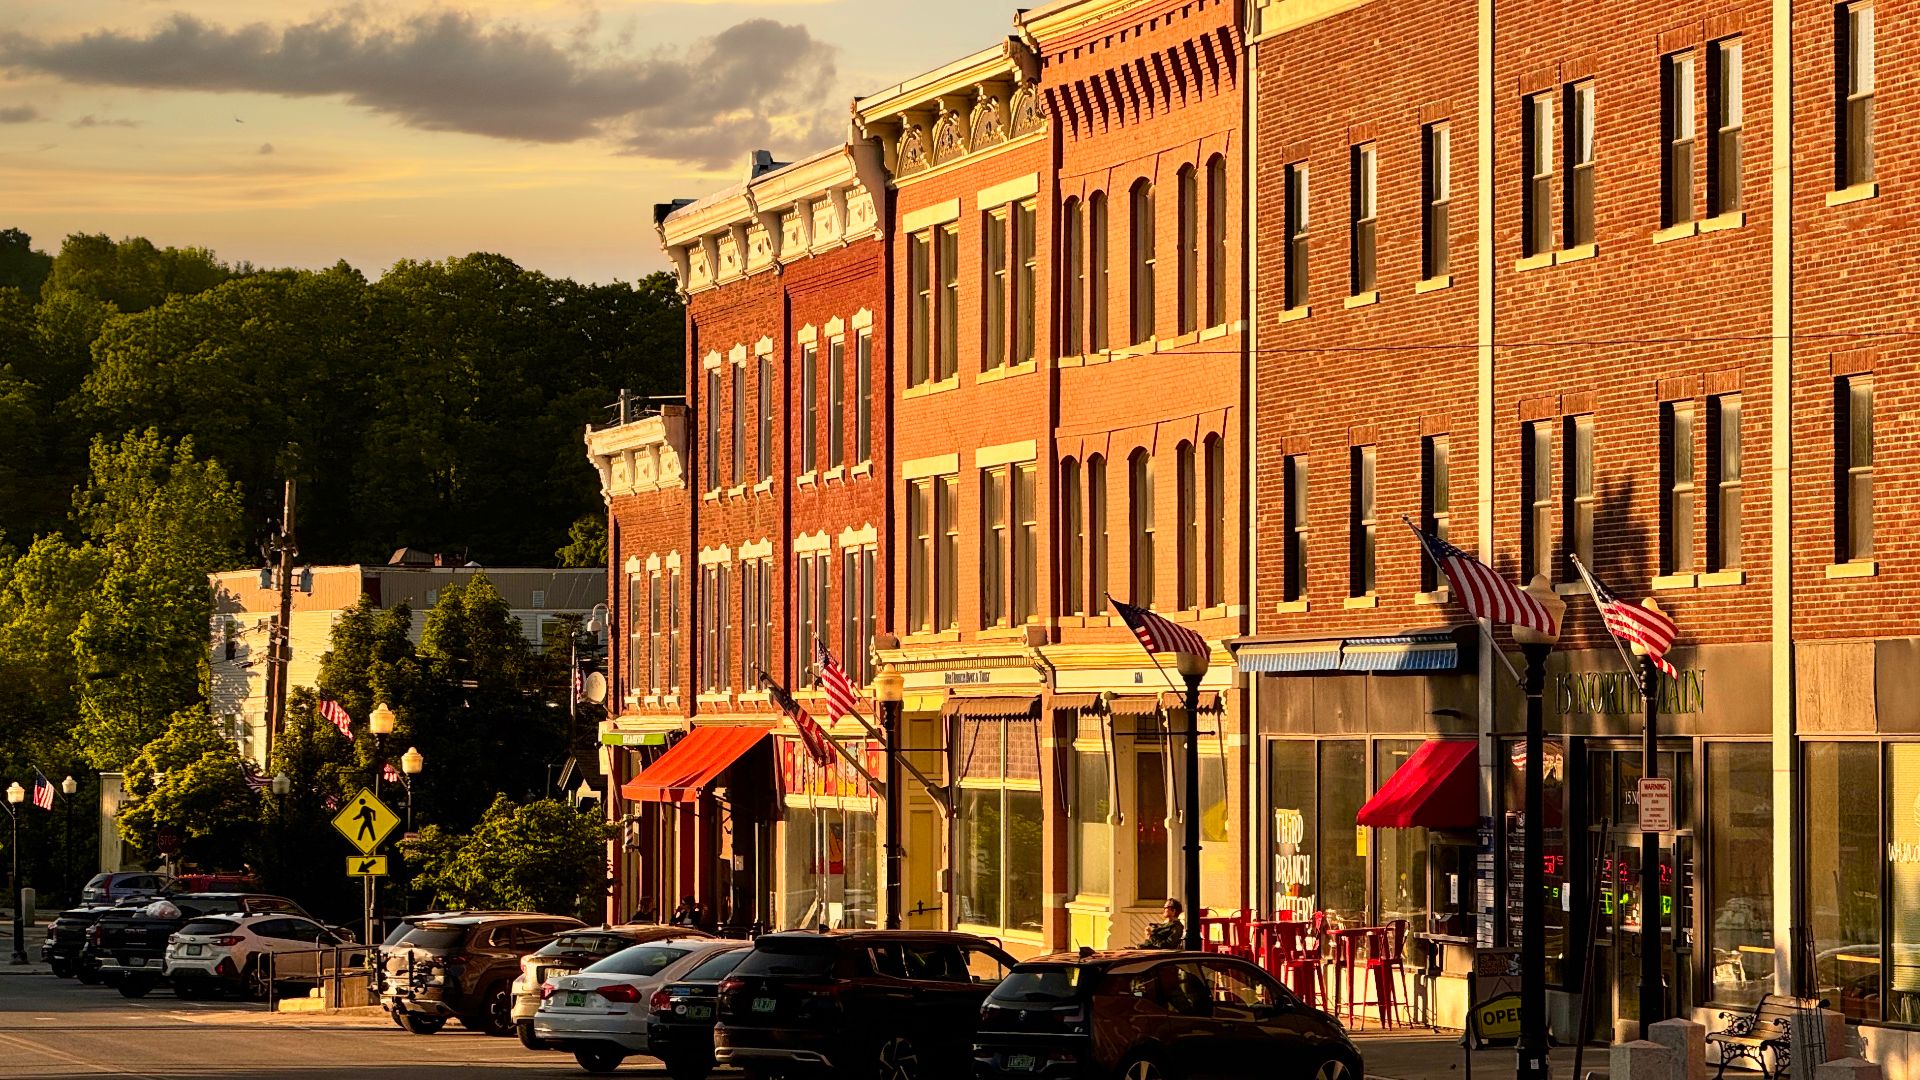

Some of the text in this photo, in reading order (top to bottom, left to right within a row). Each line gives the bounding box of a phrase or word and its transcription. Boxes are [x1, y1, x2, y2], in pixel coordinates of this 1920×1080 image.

[1555, 673, 1572, 714] 15
[1576, 672, 1643, 714] NORTH
[1275, 853, 1310, 893] BRANCH
